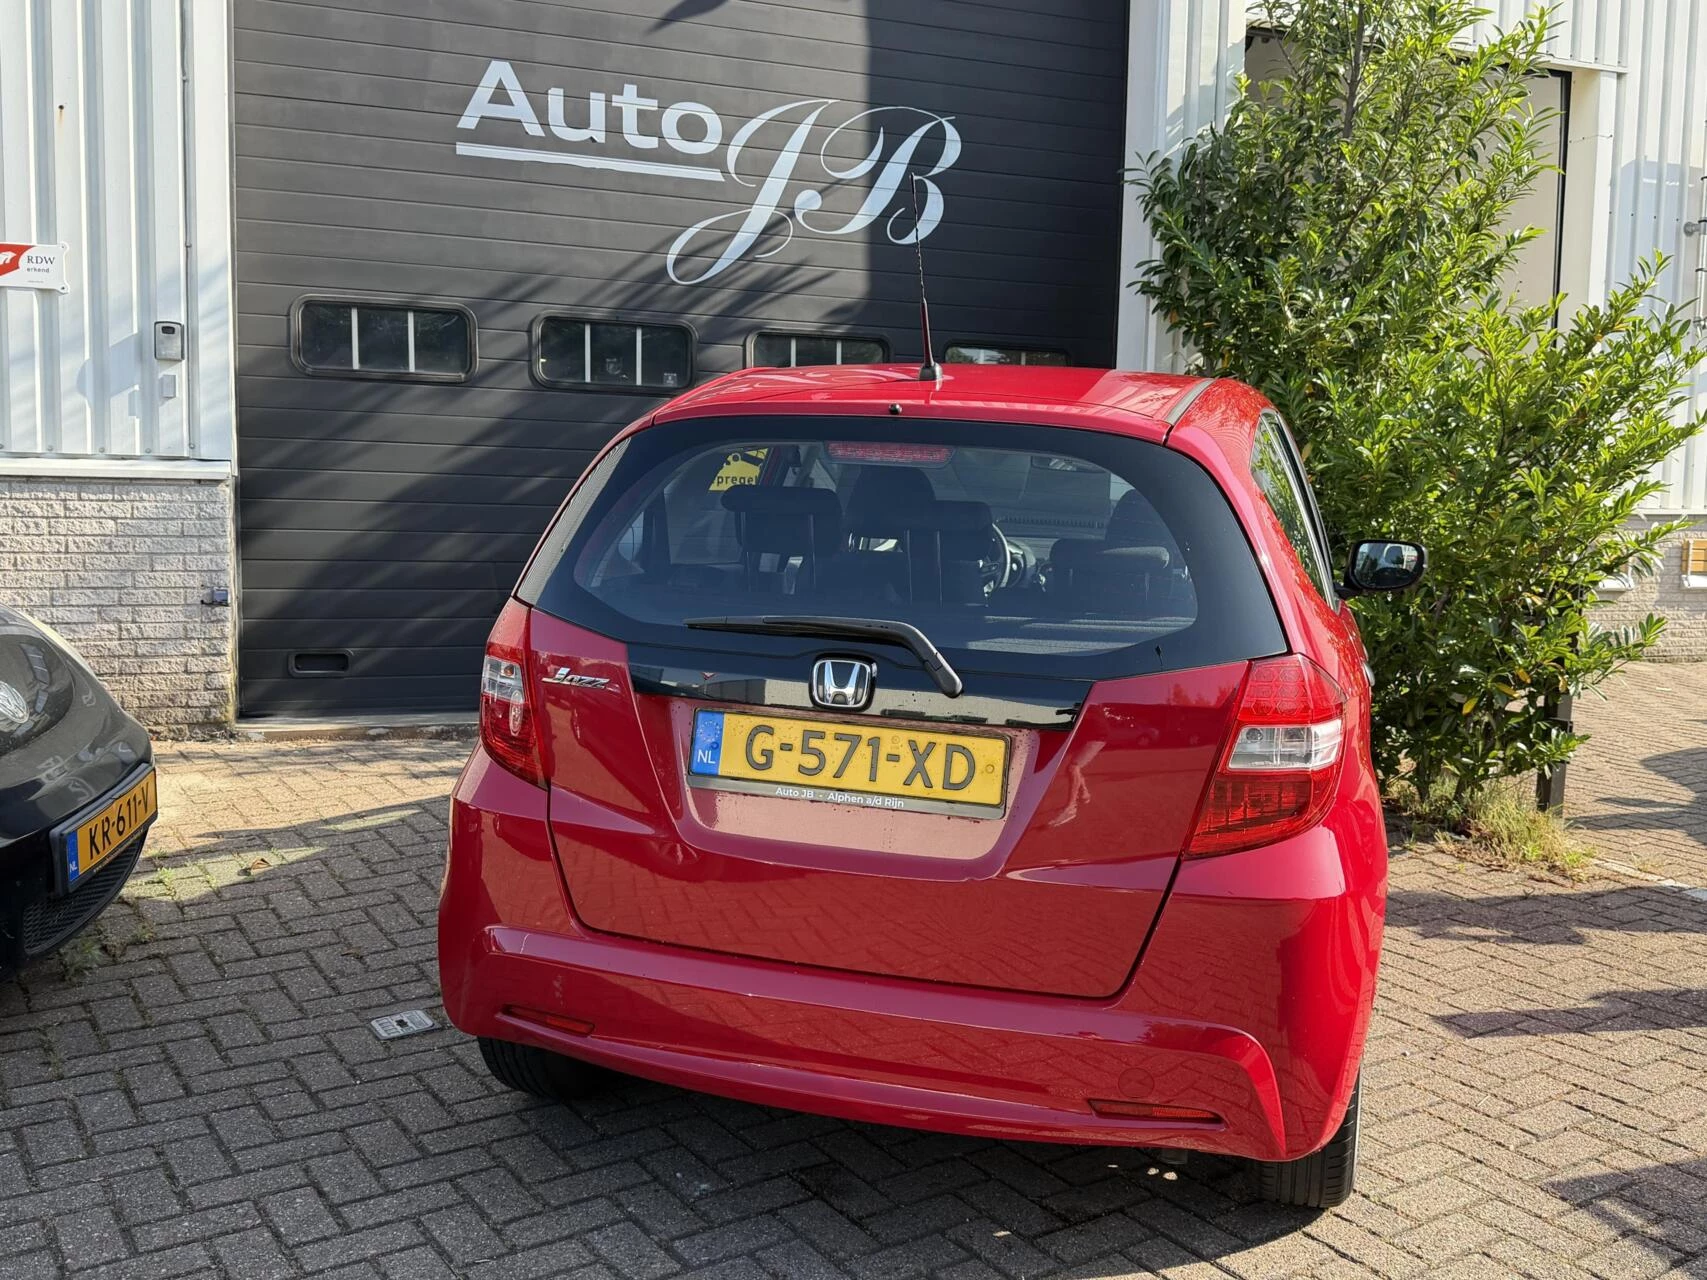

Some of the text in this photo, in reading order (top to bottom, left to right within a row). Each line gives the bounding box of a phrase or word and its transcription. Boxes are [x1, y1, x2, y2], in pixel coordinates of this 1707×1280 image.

[456, 60, 962, 285] Auto JB
[27, 255, 55, 265] RDW
[697, 749, 716, 764] NL
[745, 725, 976, 790] G-571-XD
[775, 787, 799, 797] Auto
[800, 789, 814, 798] JB
[827, 791, 864, 805] Alphen
[865, 795, 883, 806] a/d
[884, 797, 905, 809] Rijn
[89, 782, 149, 860] KR-611-V
[69, 861, 78, 873] NL
